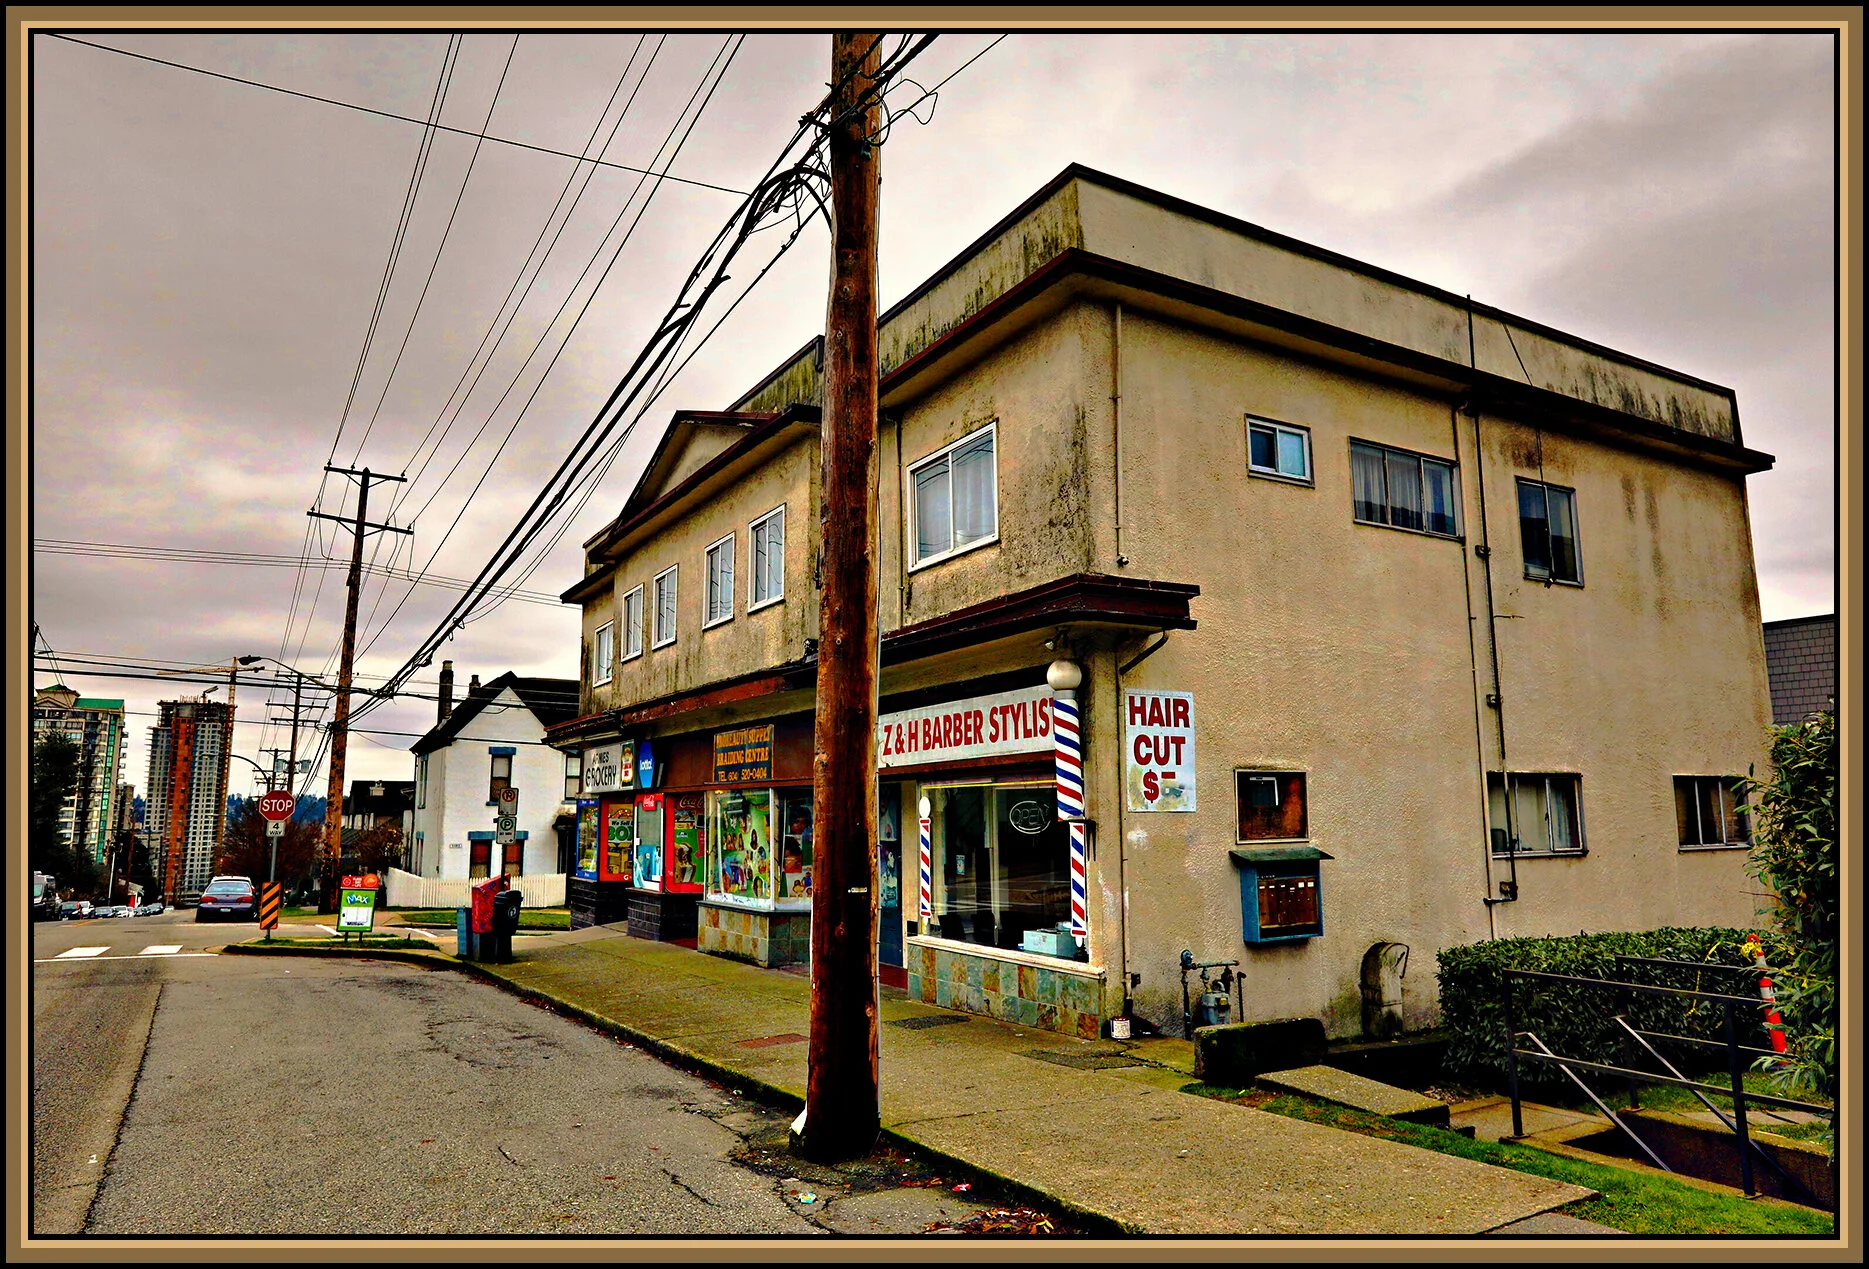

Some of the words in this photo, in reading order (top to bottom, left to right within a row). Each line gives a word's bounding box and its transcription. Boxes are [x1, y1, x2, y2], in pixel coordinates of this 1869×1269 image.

[1128, 695, 1190, 728] HAIR
[883, 724, 893, 756] Z
[894, 722, 905, 755] &
[907, 719, 919, 753] H
[922, 709, 984, 751] BARBER
[716, 749, 745, 767] BRAIDING
[745, 746, 769, 763] CENTRE
[1133, 734, 1186, 766] CUT
[585, 764, 617, 788] GROCERY
[262, 799, 293, 812] STOP
[272, 822, 280, 830] 4
[346, 893, 370, 905] MAX
